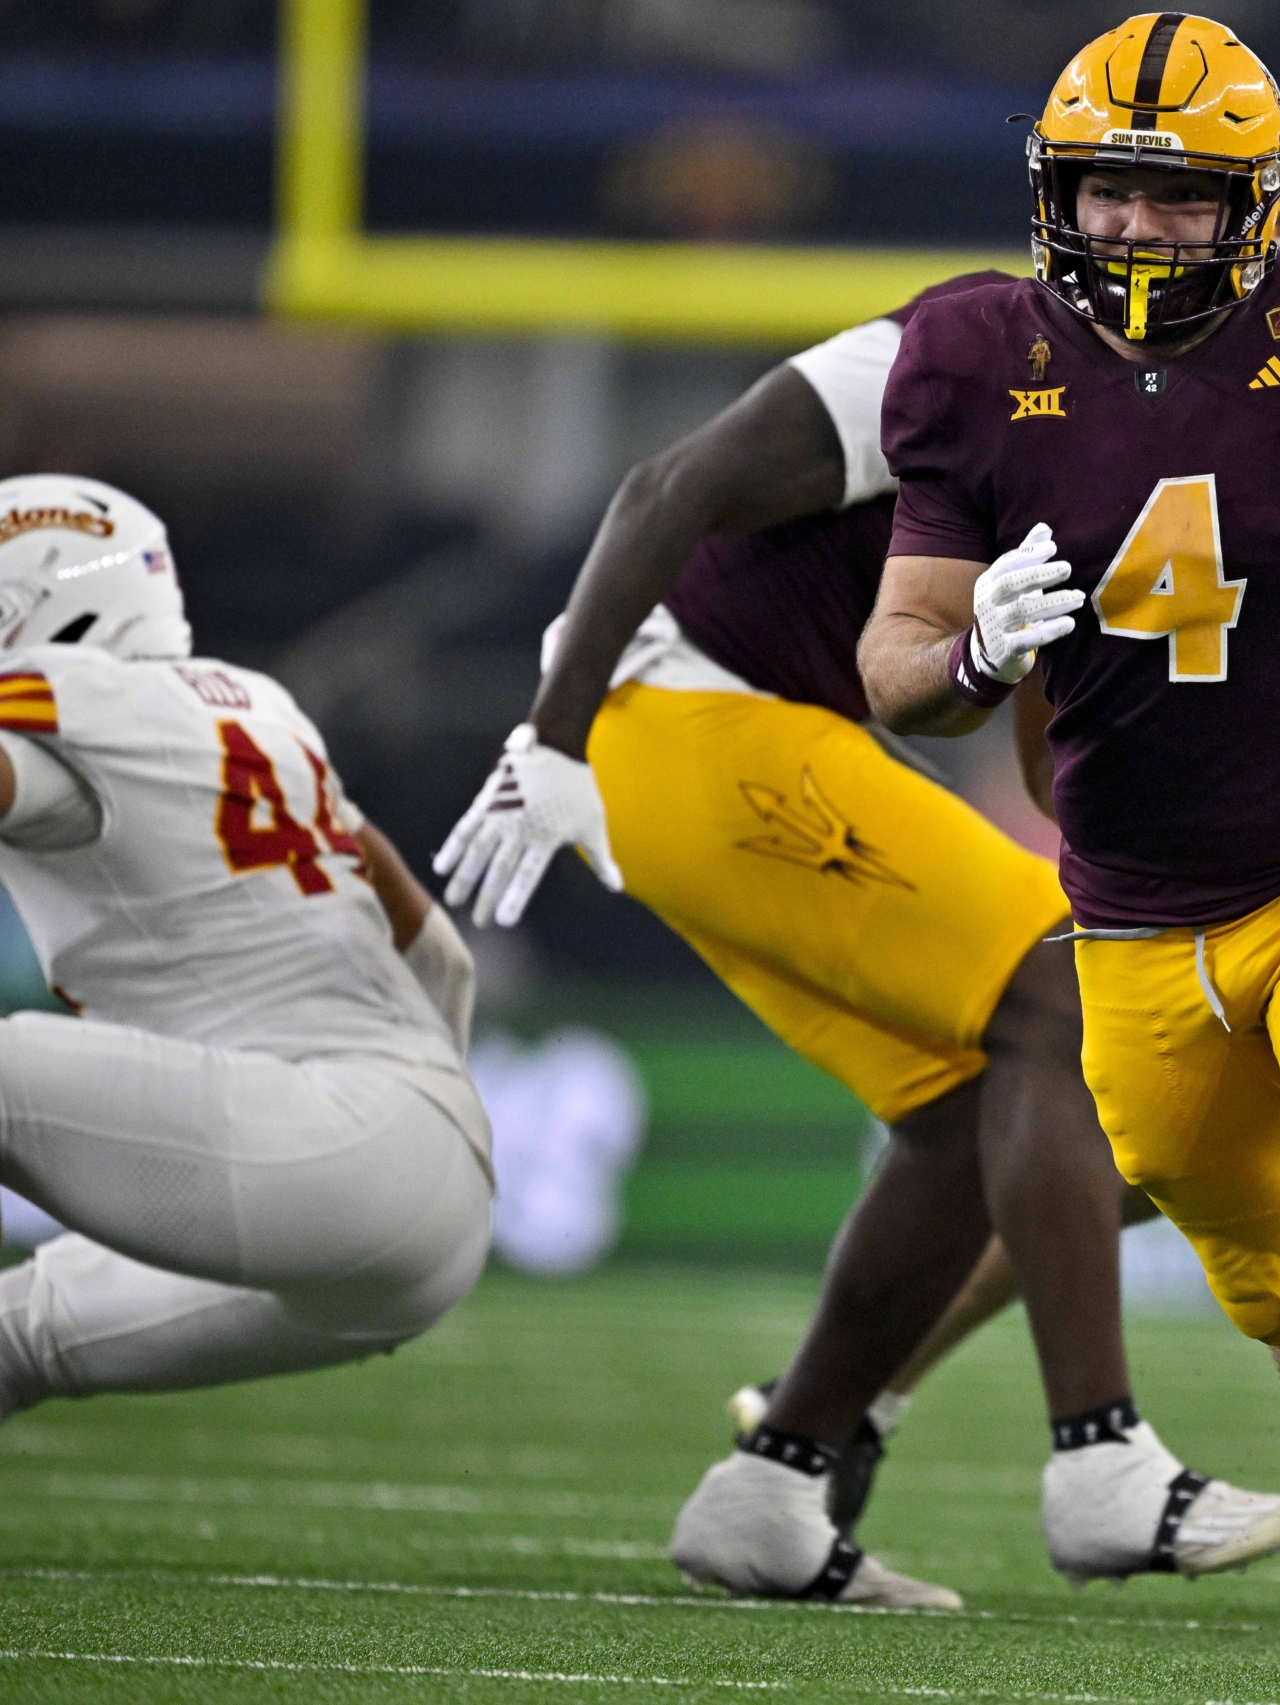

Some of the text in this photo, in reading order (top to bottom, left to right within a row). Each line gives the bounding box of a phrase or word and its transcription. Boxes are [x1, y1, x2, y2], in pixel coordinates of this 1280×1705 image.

[1111, 133, 1172, 148] SUN DEVILS
[1240, 201, 1266, 236] dell
[1145, 373, 1157, 381] PT
[1145, 384, 1157, 393] 42
[1008, 385, 1067, 421] XII
[0, 507, 115, 544] clones
[1090, 473, 1248, 683] 4
